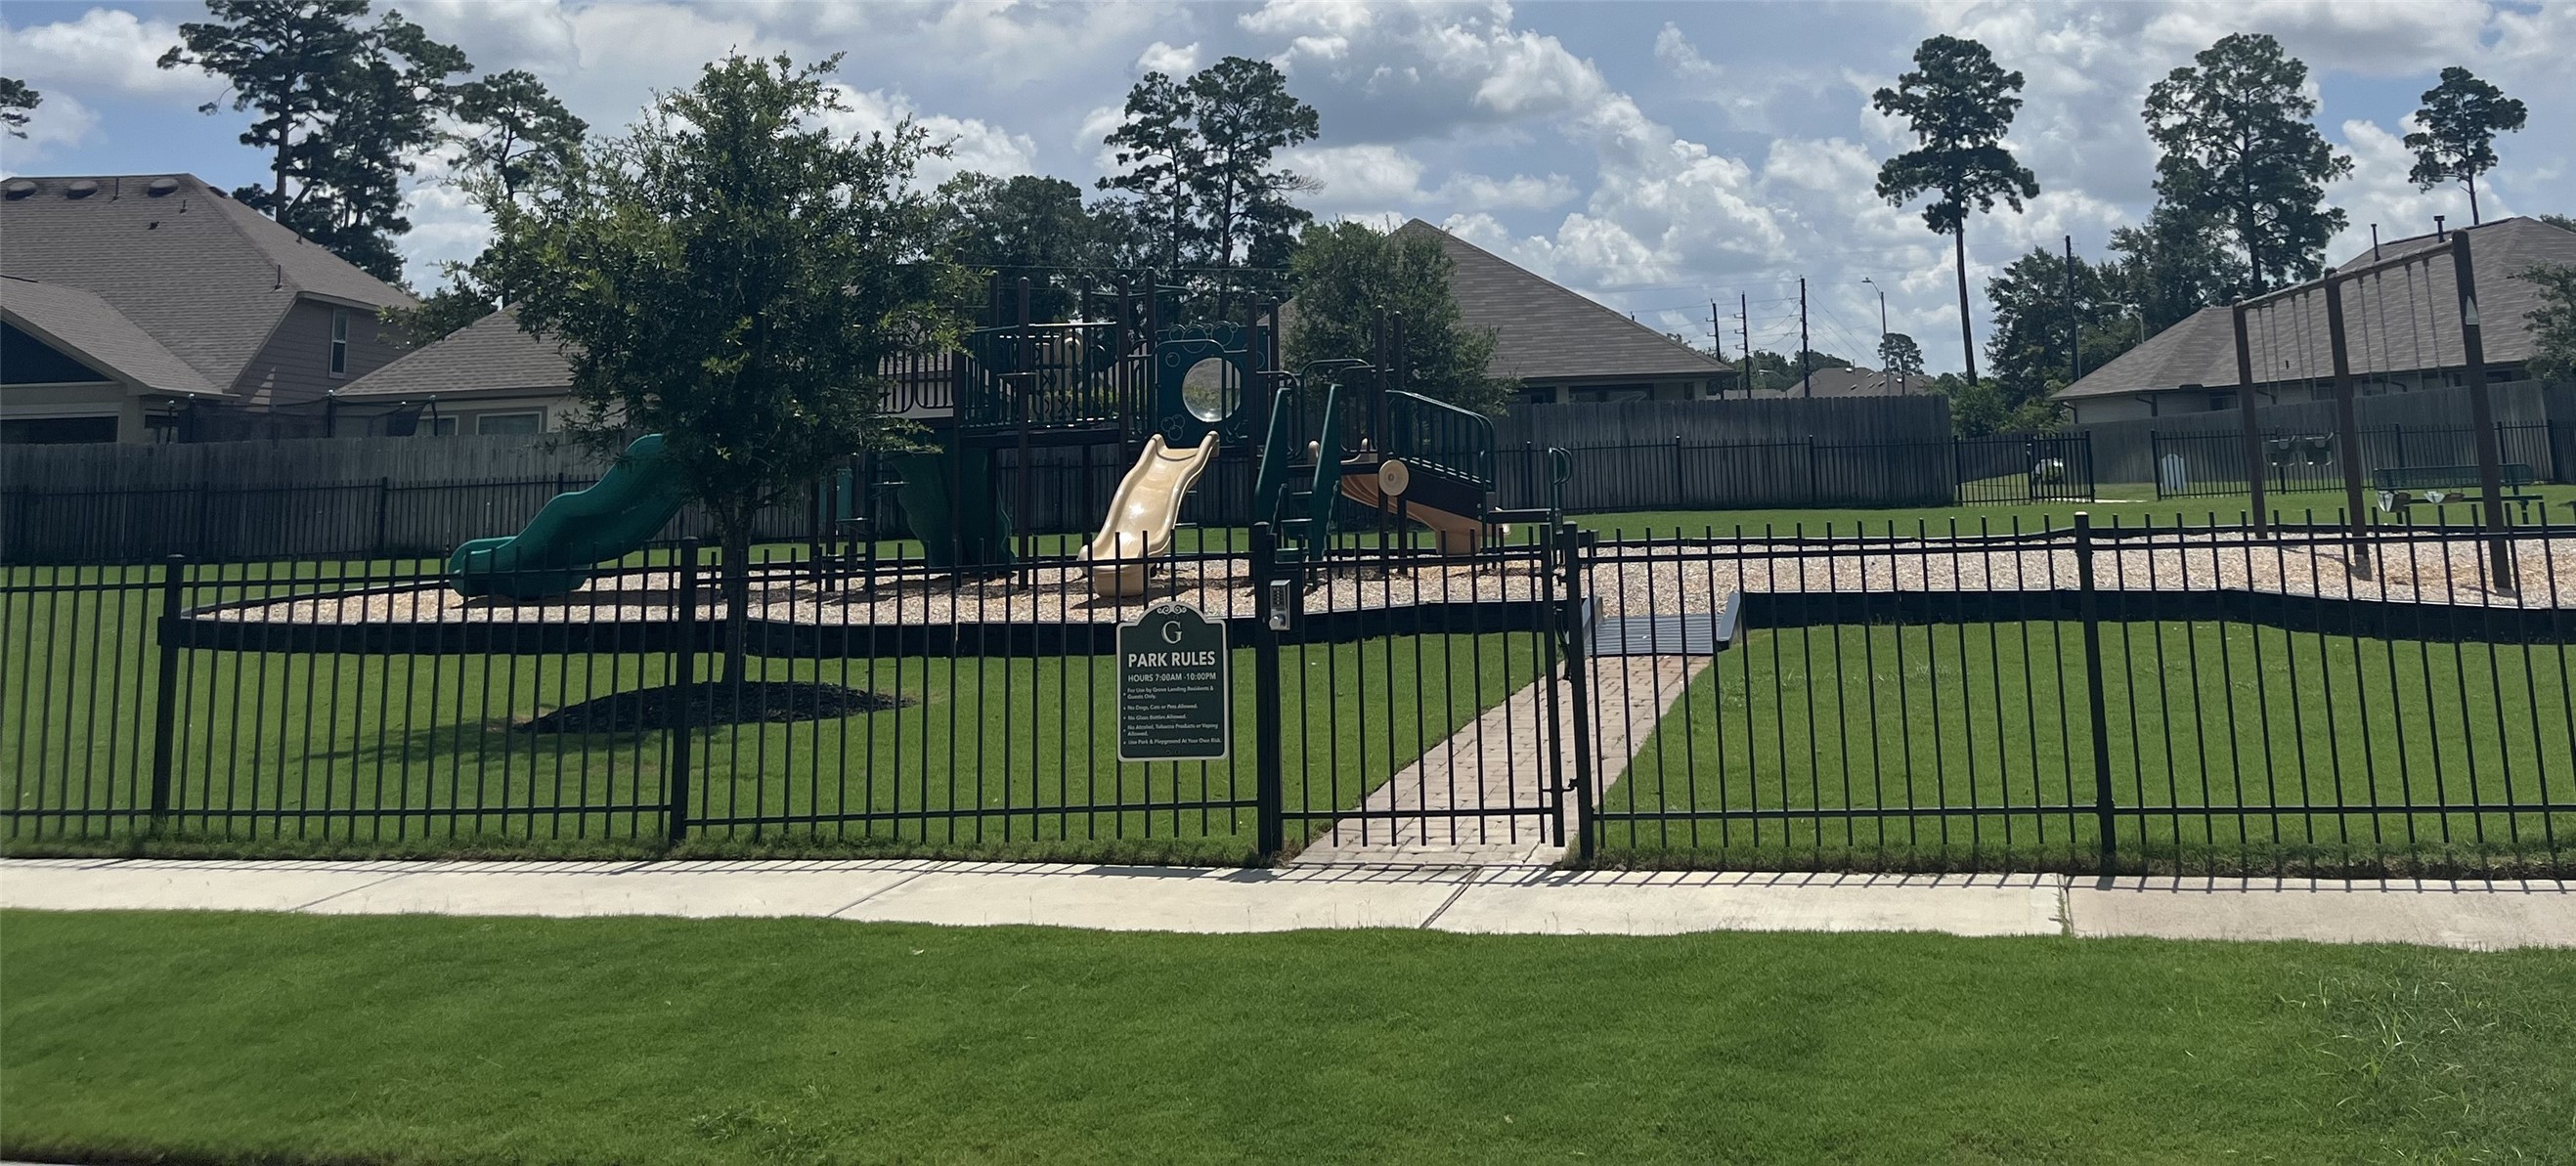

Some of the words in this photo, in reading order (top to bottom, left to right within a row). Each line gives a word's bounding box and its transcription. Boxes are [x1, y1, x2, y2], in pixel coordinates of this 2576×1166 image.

[1161, 621, 1182, 643] G
[1128, 653, 1168, 668] PARK
[1171, 651, 1215, 666] RULES
